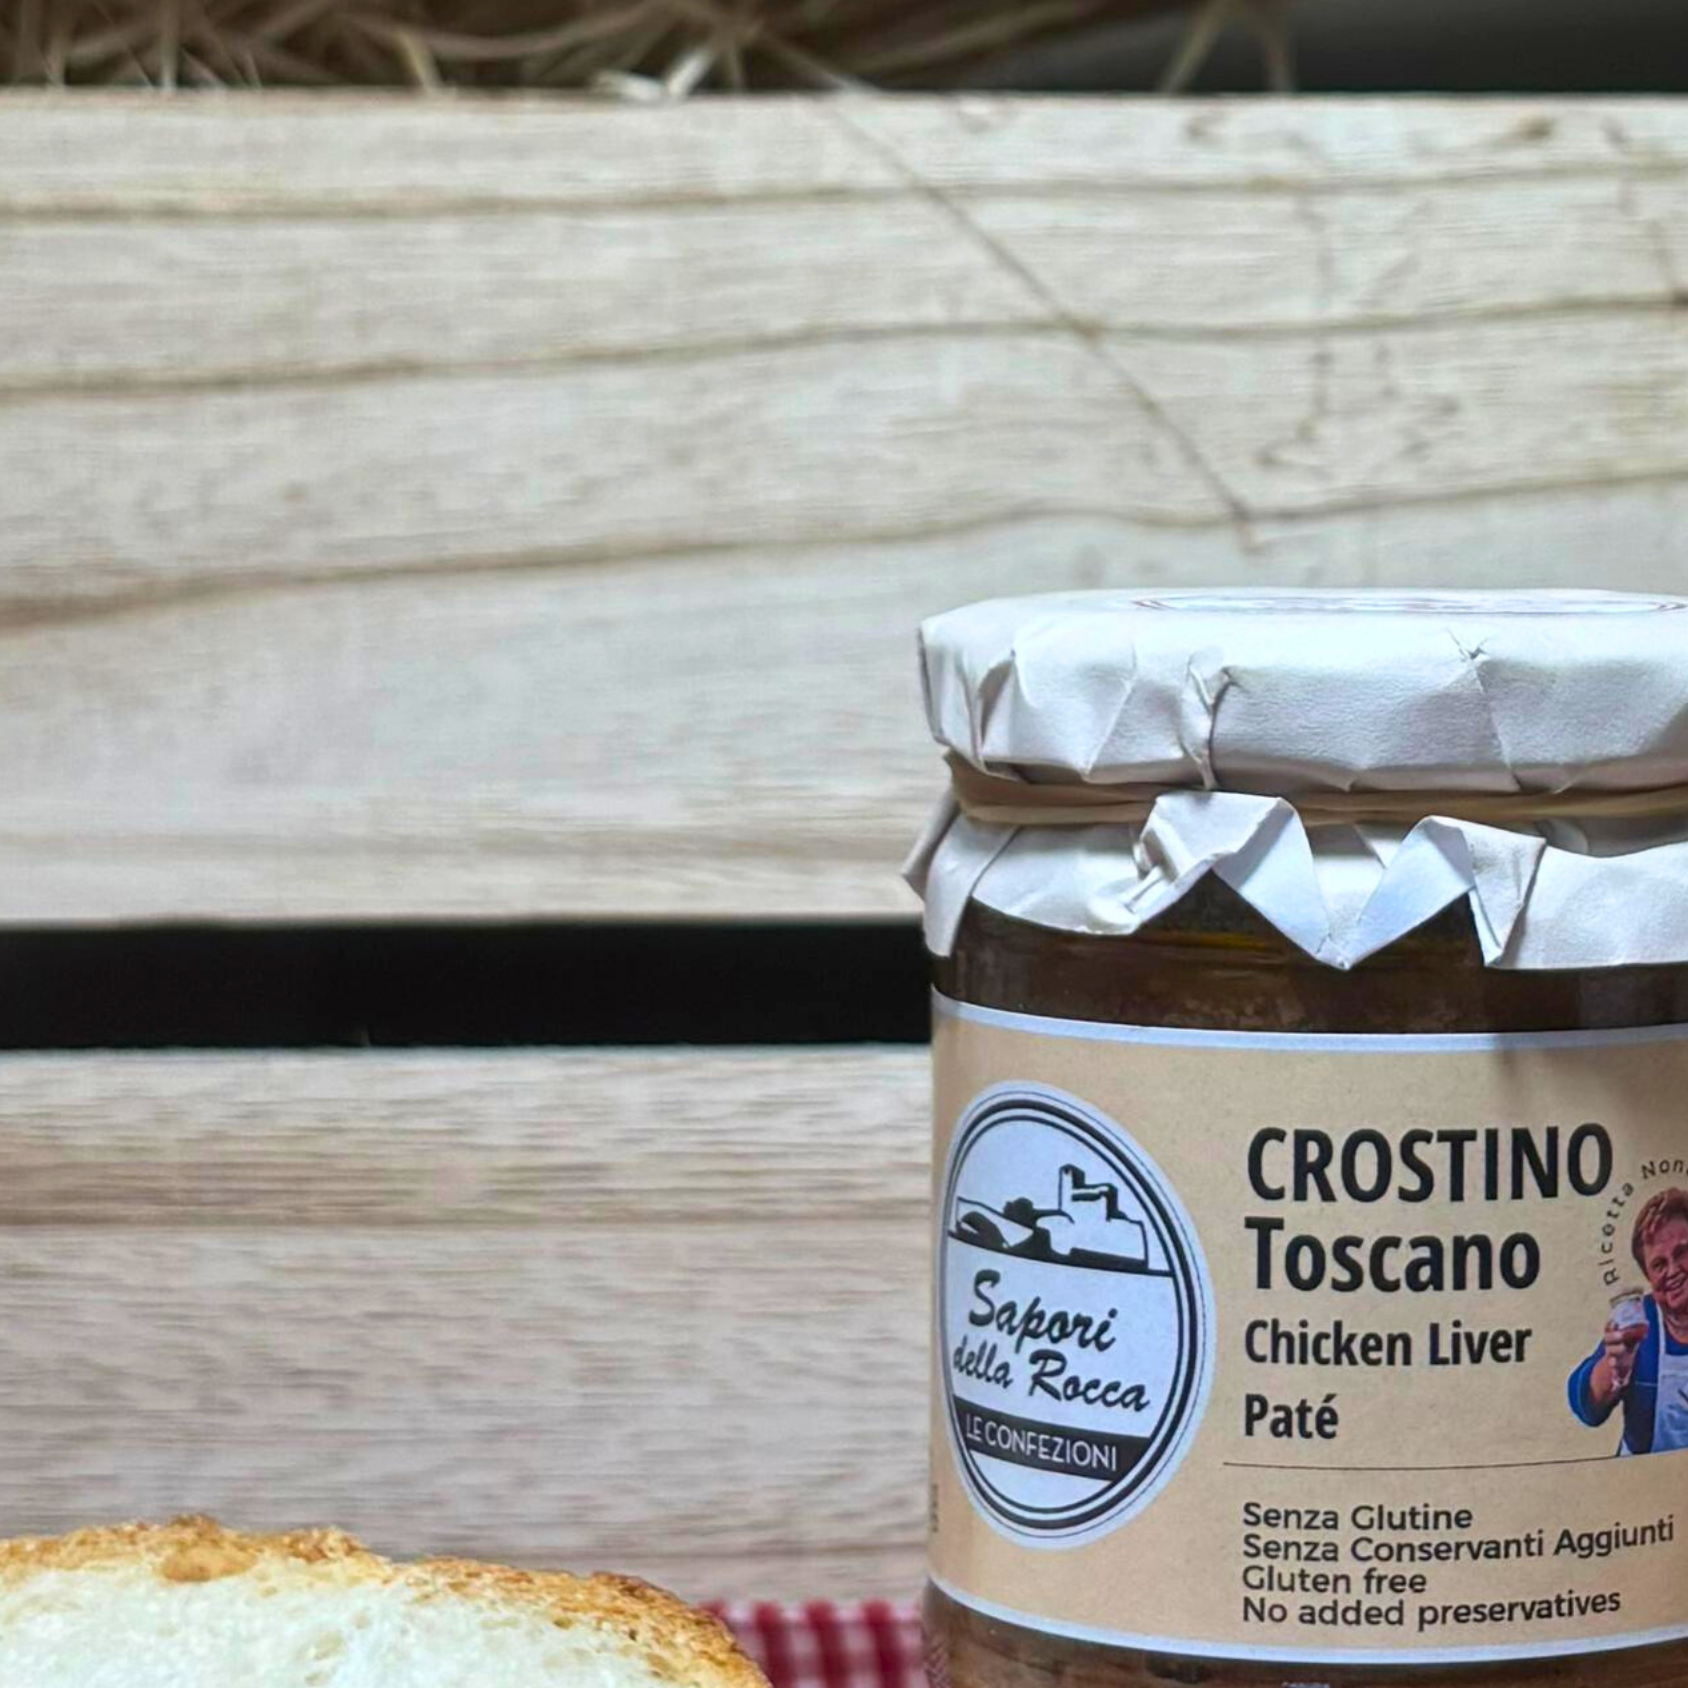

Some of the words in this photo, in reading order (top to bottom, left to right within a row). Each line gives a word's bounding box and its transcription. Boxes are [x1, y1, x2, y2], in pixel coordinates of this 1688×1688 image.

[1248, 1123, 1613, 1202] CROSTINO
[1244, 1216, 1540, 1293] Toscano
[968, 1268, 1118, 1354] Sapori
[1245, 1318, 1412, 1367] Chicken
[1428, 1318, 1533, 1366] Liver
[953, 1333, 1014, 1390] della
[1028, 1348, 1151, 1413] Rocca
[1244, 1393, 1340, 1440] Paté
[966, 1413, 983, 1442] LE
[984, 1419, 1118, 1472] CONFEZIONI
[1243, 1502, 1340, 1530] Senza
[1350, 1503, 1474, 1531] Glutine
[1243, 1533, 1340, 1562] Senza
[1350, 1529, 1544, 1563] Conservanti
[1553, 1514, 1674, 1559] Aggiunti
[1242, 1564, 1352, 1594] Gluten
[1363, 1566, 1428, 1594] free
[1243, 1596, 1288, 1622] No
[1298, 1600, 1404, 1626] added
[1418, 1589, 1621, 1633] preservatives
